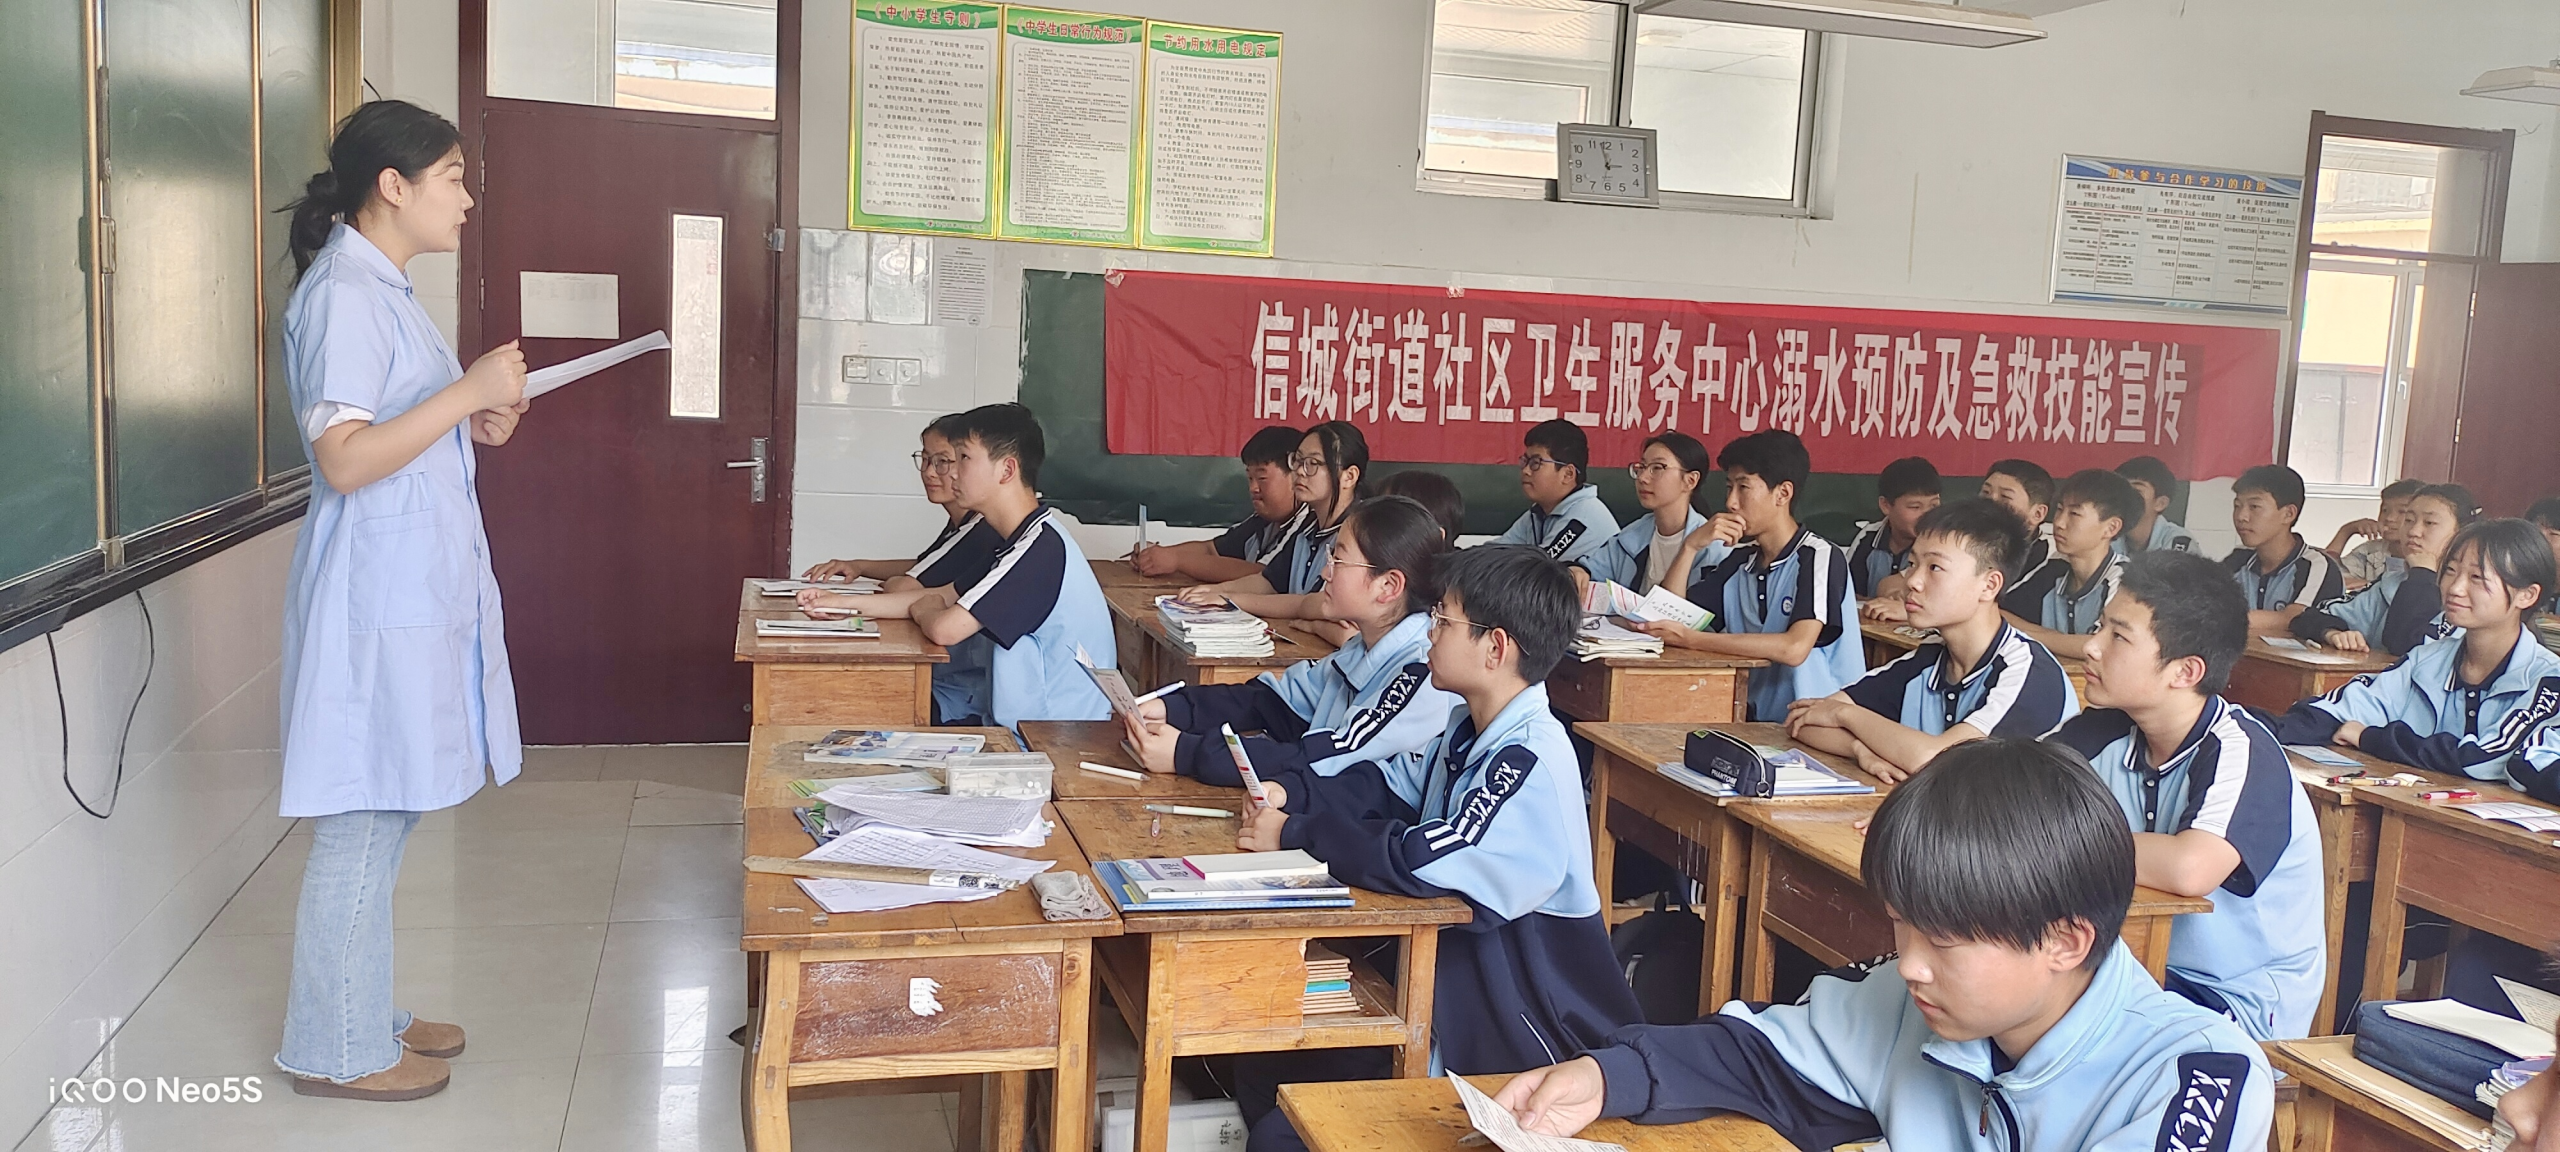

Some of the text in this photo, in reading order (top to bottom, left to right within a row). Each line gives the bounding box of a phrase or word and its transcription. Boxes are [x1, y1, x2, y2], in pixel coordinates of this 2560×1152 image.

[875, 3, 981, 29] 《中小学生守则》
[1017, 17, 1133, 44] 《中学生日常行为规范》
[1163, 33, 1267, 58] 节约用水用电规定
[1574, 144, 1583, 153] 10
[1588, 140, 1597, 149] 11
[1602, 141, 1612, 150] 12
[1619, 142, 1624, 151] 1
[1631, 149, 1639, 159] 2
[1575, 159, 1583, 168] 9
[1631, 163, 1639, 173] 3
[1575, 174, 1583, 184] 8
[1632, 178, 1640, 187] 4
[1589, 180, 1597, 190] 7
[1604, 182, 1612, 192] 6
[1618, 182, 1627, 192] 5
[1250, 299, 2188, 446] 信城街道社区卫生服务中心溺水预防及急救技能宣传
